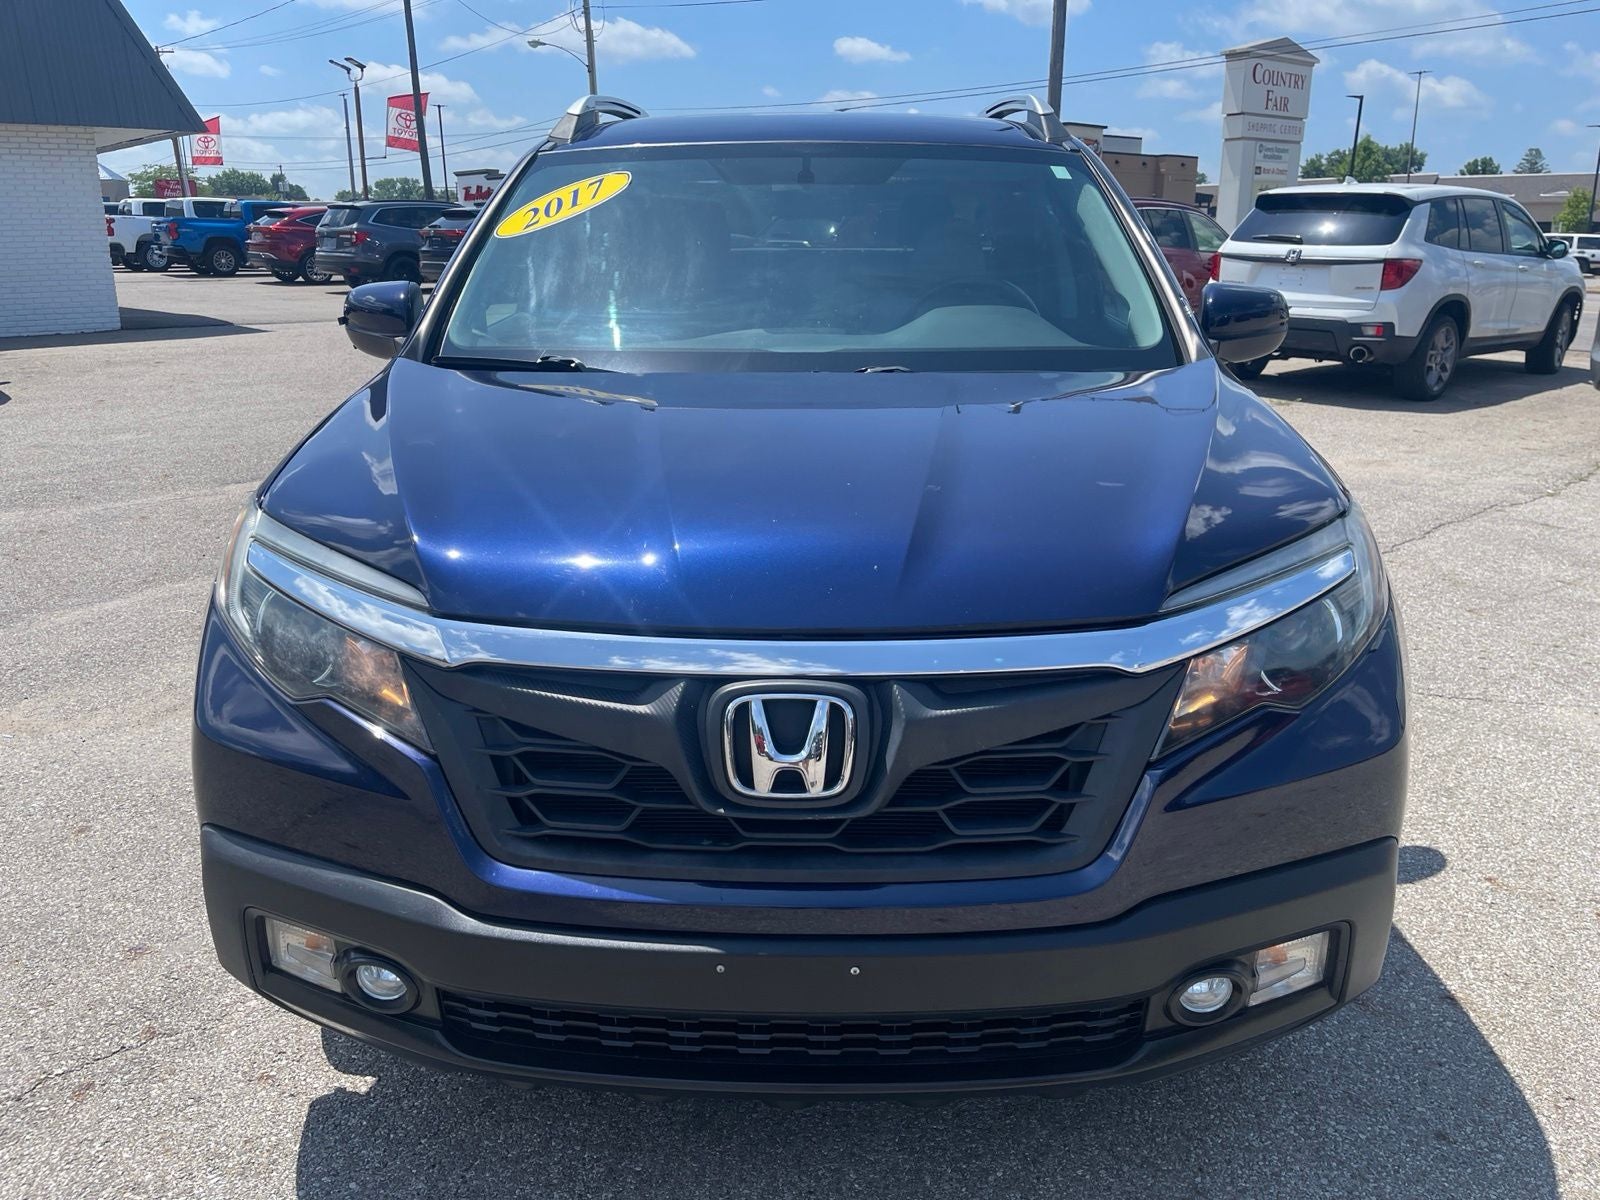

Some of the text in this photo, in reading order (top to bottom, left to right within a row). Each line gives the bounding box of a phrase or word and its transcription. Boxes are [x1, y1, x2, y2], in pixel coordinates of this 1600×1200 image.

[1252, 62, 1307, 90] COUNTRY
[1264, 89, 1290, 113] FAIR
[1248, 121, 1302, 136] SHOPPING CENTER
[522, 177, 605, 231] 2017
